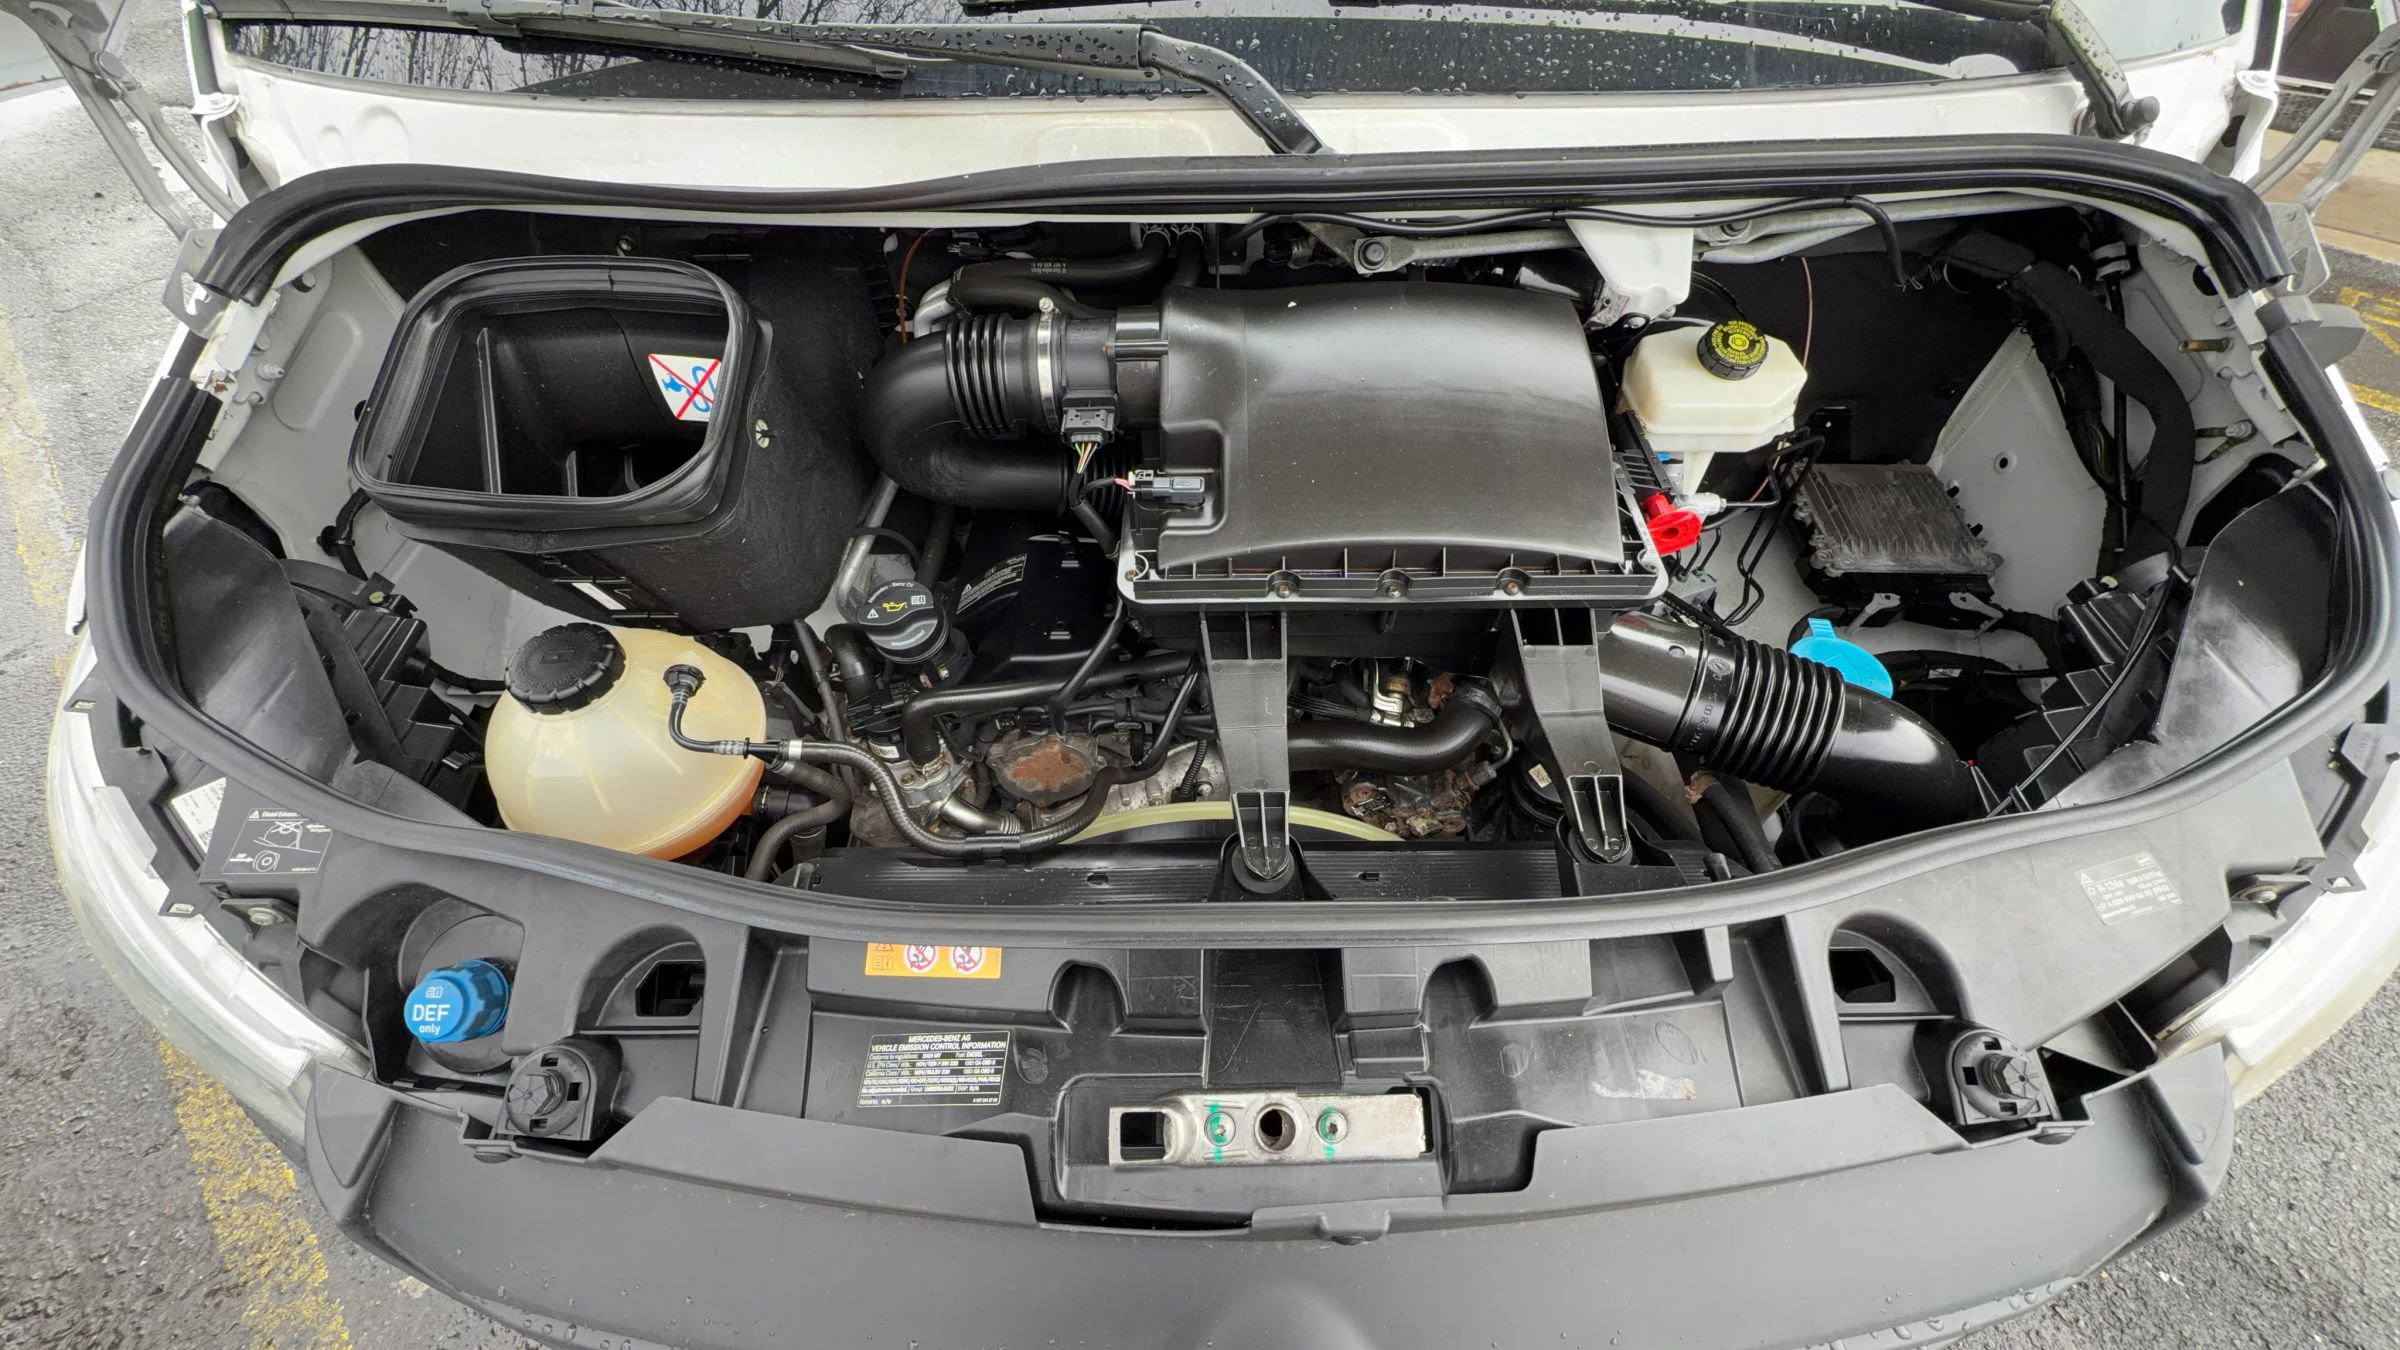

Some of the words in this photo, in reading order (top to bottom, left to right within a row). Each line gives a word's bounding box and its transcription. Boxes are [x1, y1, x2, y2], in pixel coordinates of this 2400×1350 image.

[412, 1004, 451, 1022] DEF
[419, 1023, 441, 1036] only
[908, 1034, 961, 1043] MERCEDES-BENZ
[961, 1034, 972, 1042] AG
[871, 1044, 899, 1052] VEHICLE
[898, 1043, 929, 1051] EMISSION
[930, 1042, 961, 1051] CONTROL
[961, 1041, 1007, 1050] INFORMATION
